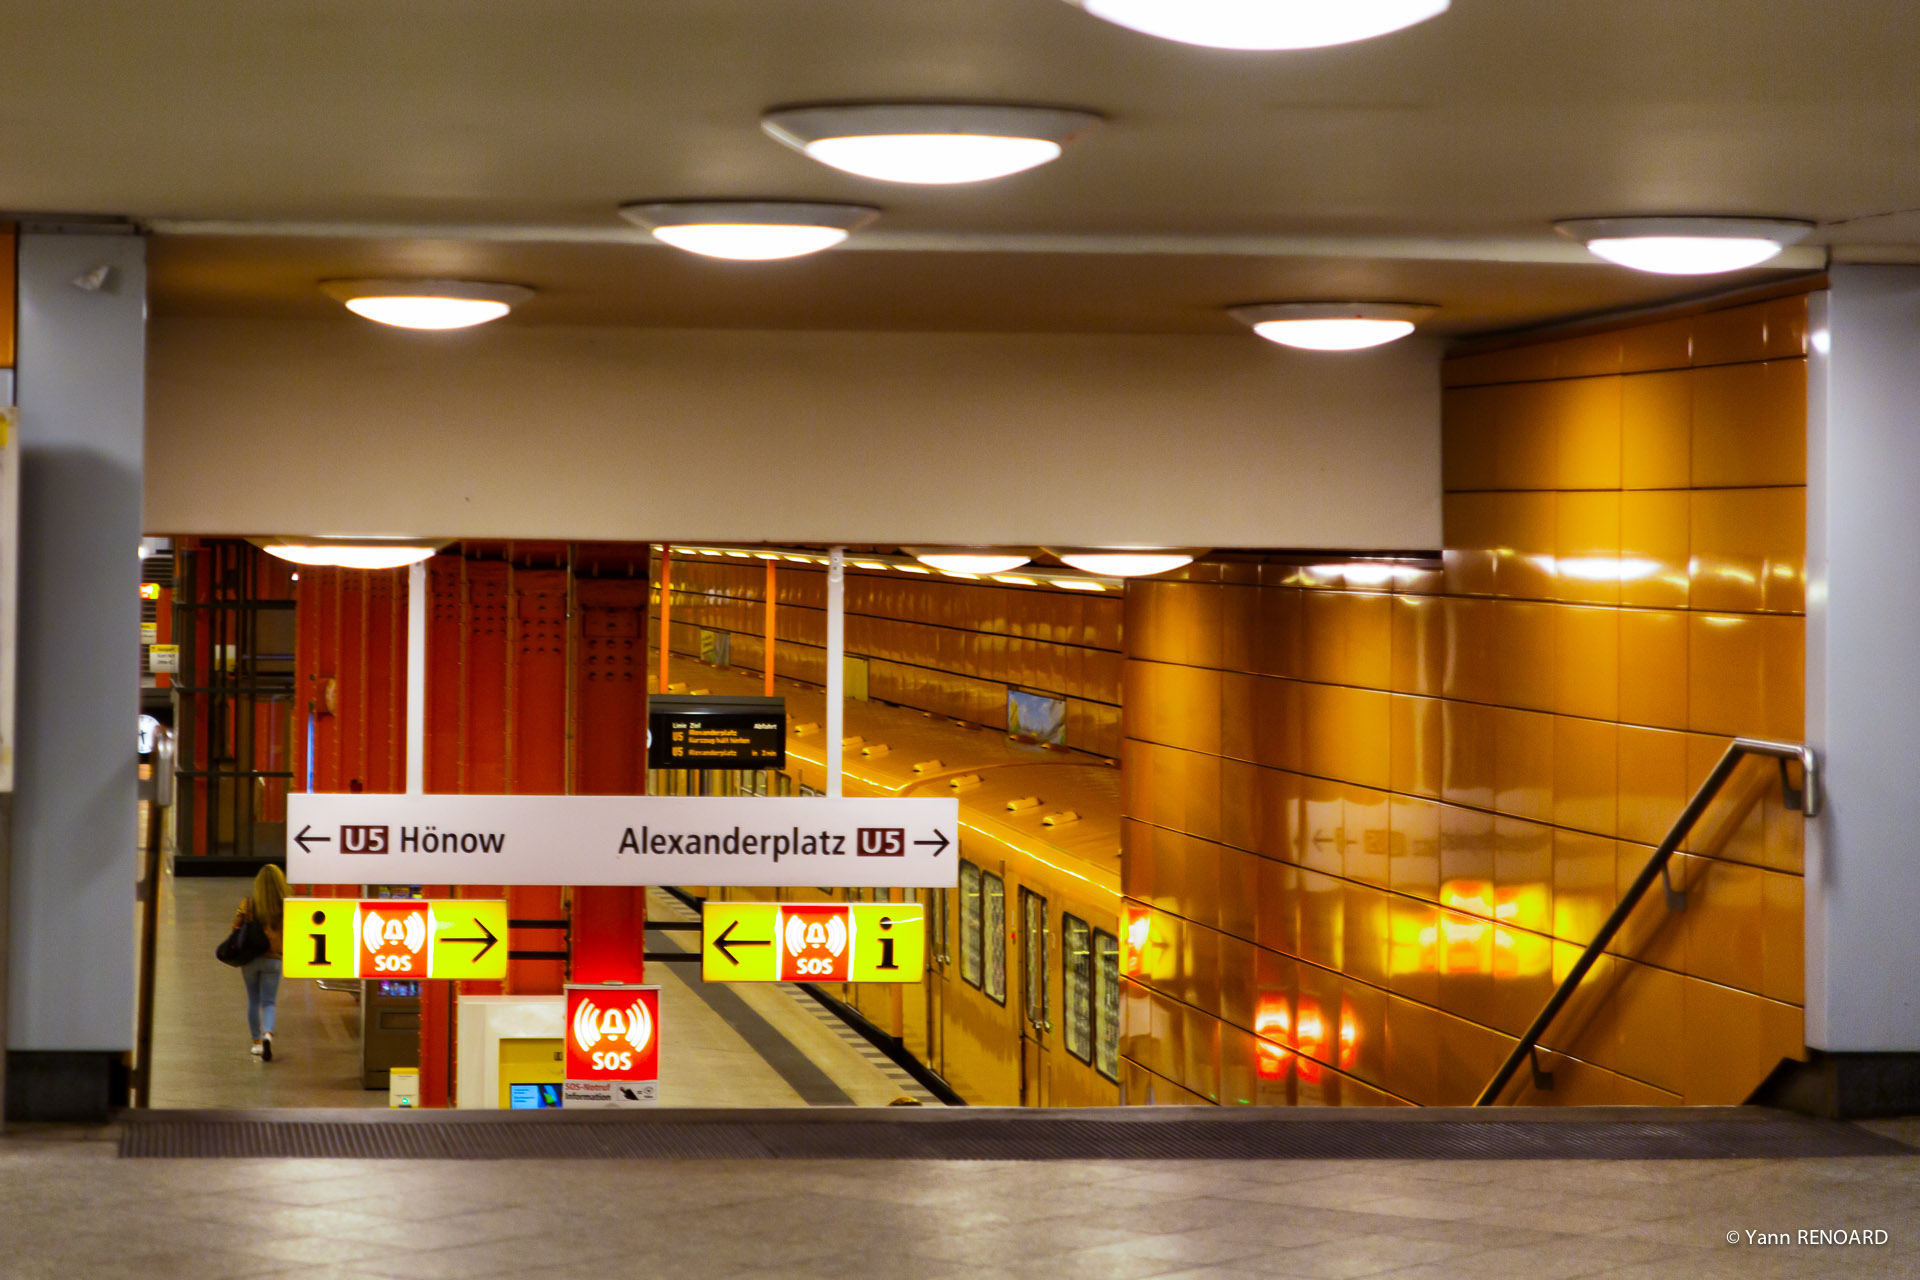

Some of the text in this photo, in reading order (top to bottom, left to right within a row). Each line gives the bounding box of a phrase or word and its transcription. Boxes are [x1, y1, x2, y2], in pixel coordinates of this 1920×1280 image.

[672, 731, 684, 742] U5
[672, 746, 684, 757] U5
[344, 826, 505, 853] U5 Hönow
[618, 826, 901, 862] Alexanderplatz U5
[375, 954, 412, 972] SOS
[796, 958, 833, 975] SOS
[592, 1051, 632, 1071] SOS
[565, 1082, 611, 1091] SOS-Notruf
[565, 1092, 611, 1101] Information
